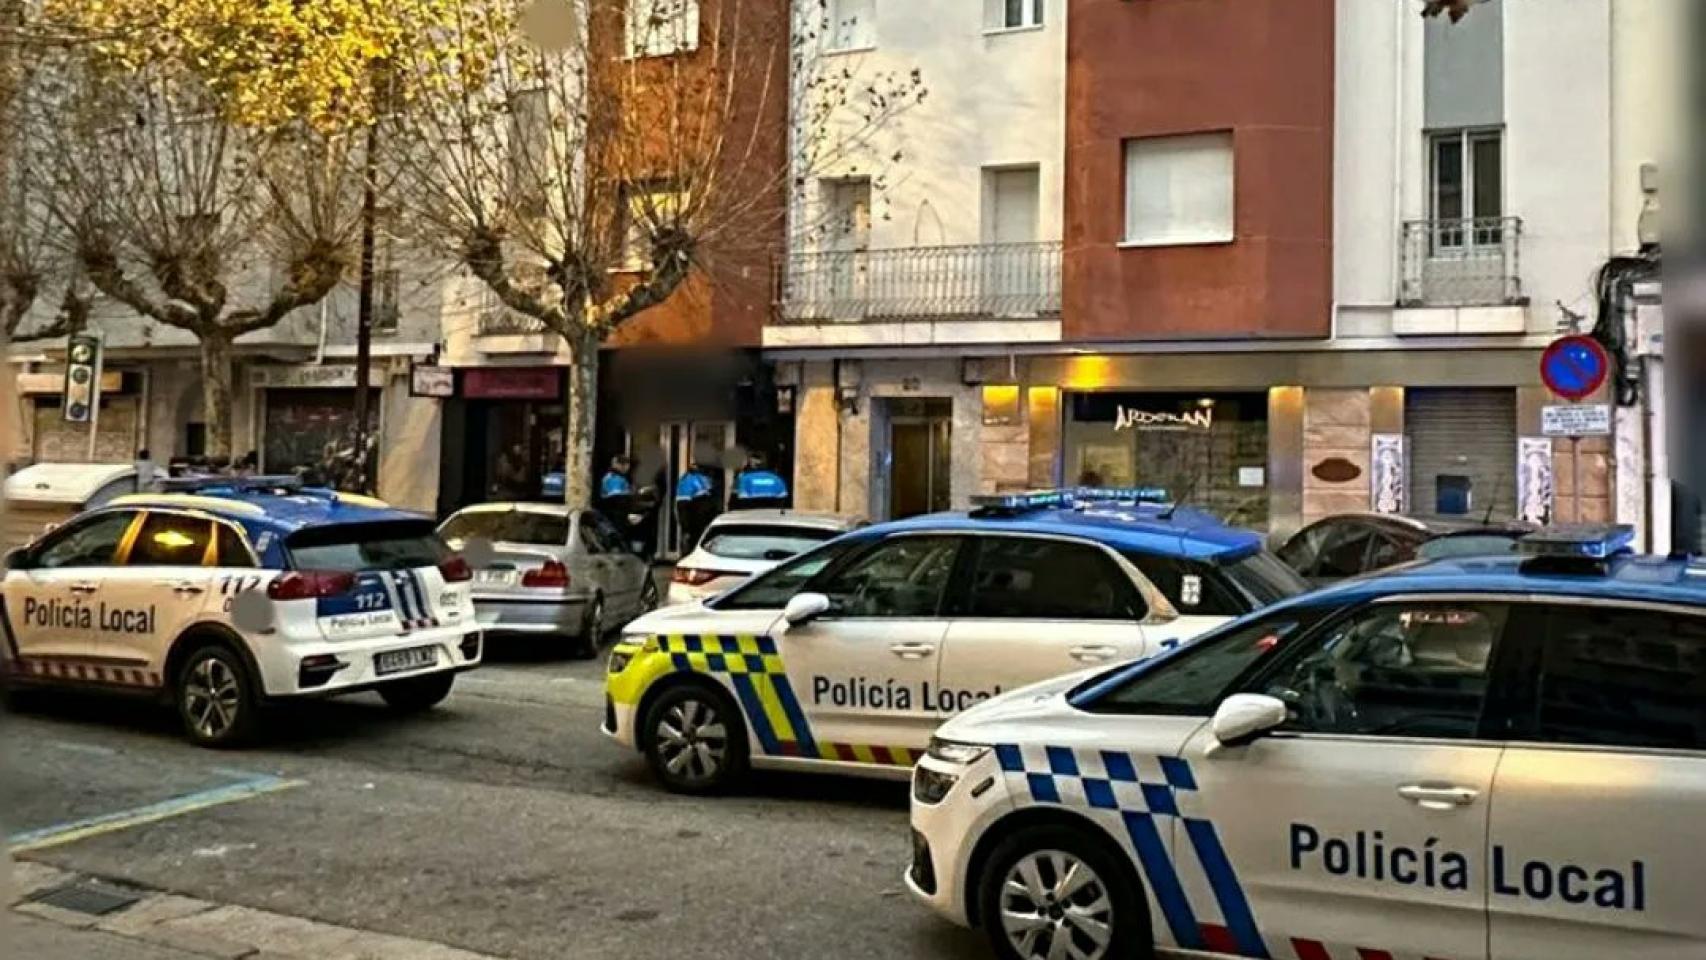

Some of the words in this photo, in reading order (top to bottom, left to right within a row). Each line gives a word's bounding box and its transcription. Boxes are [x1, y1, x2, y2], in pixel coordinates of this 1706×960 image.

[24, 597, 91, 629] Policía
[100, 601, 156, 634] Local
[355, 592, 385, 609] 112
[813, 675, 911, 709] Policía
[1290, 823, 1468, 890] Policía
[1493, 845, 1644, 911] Local
